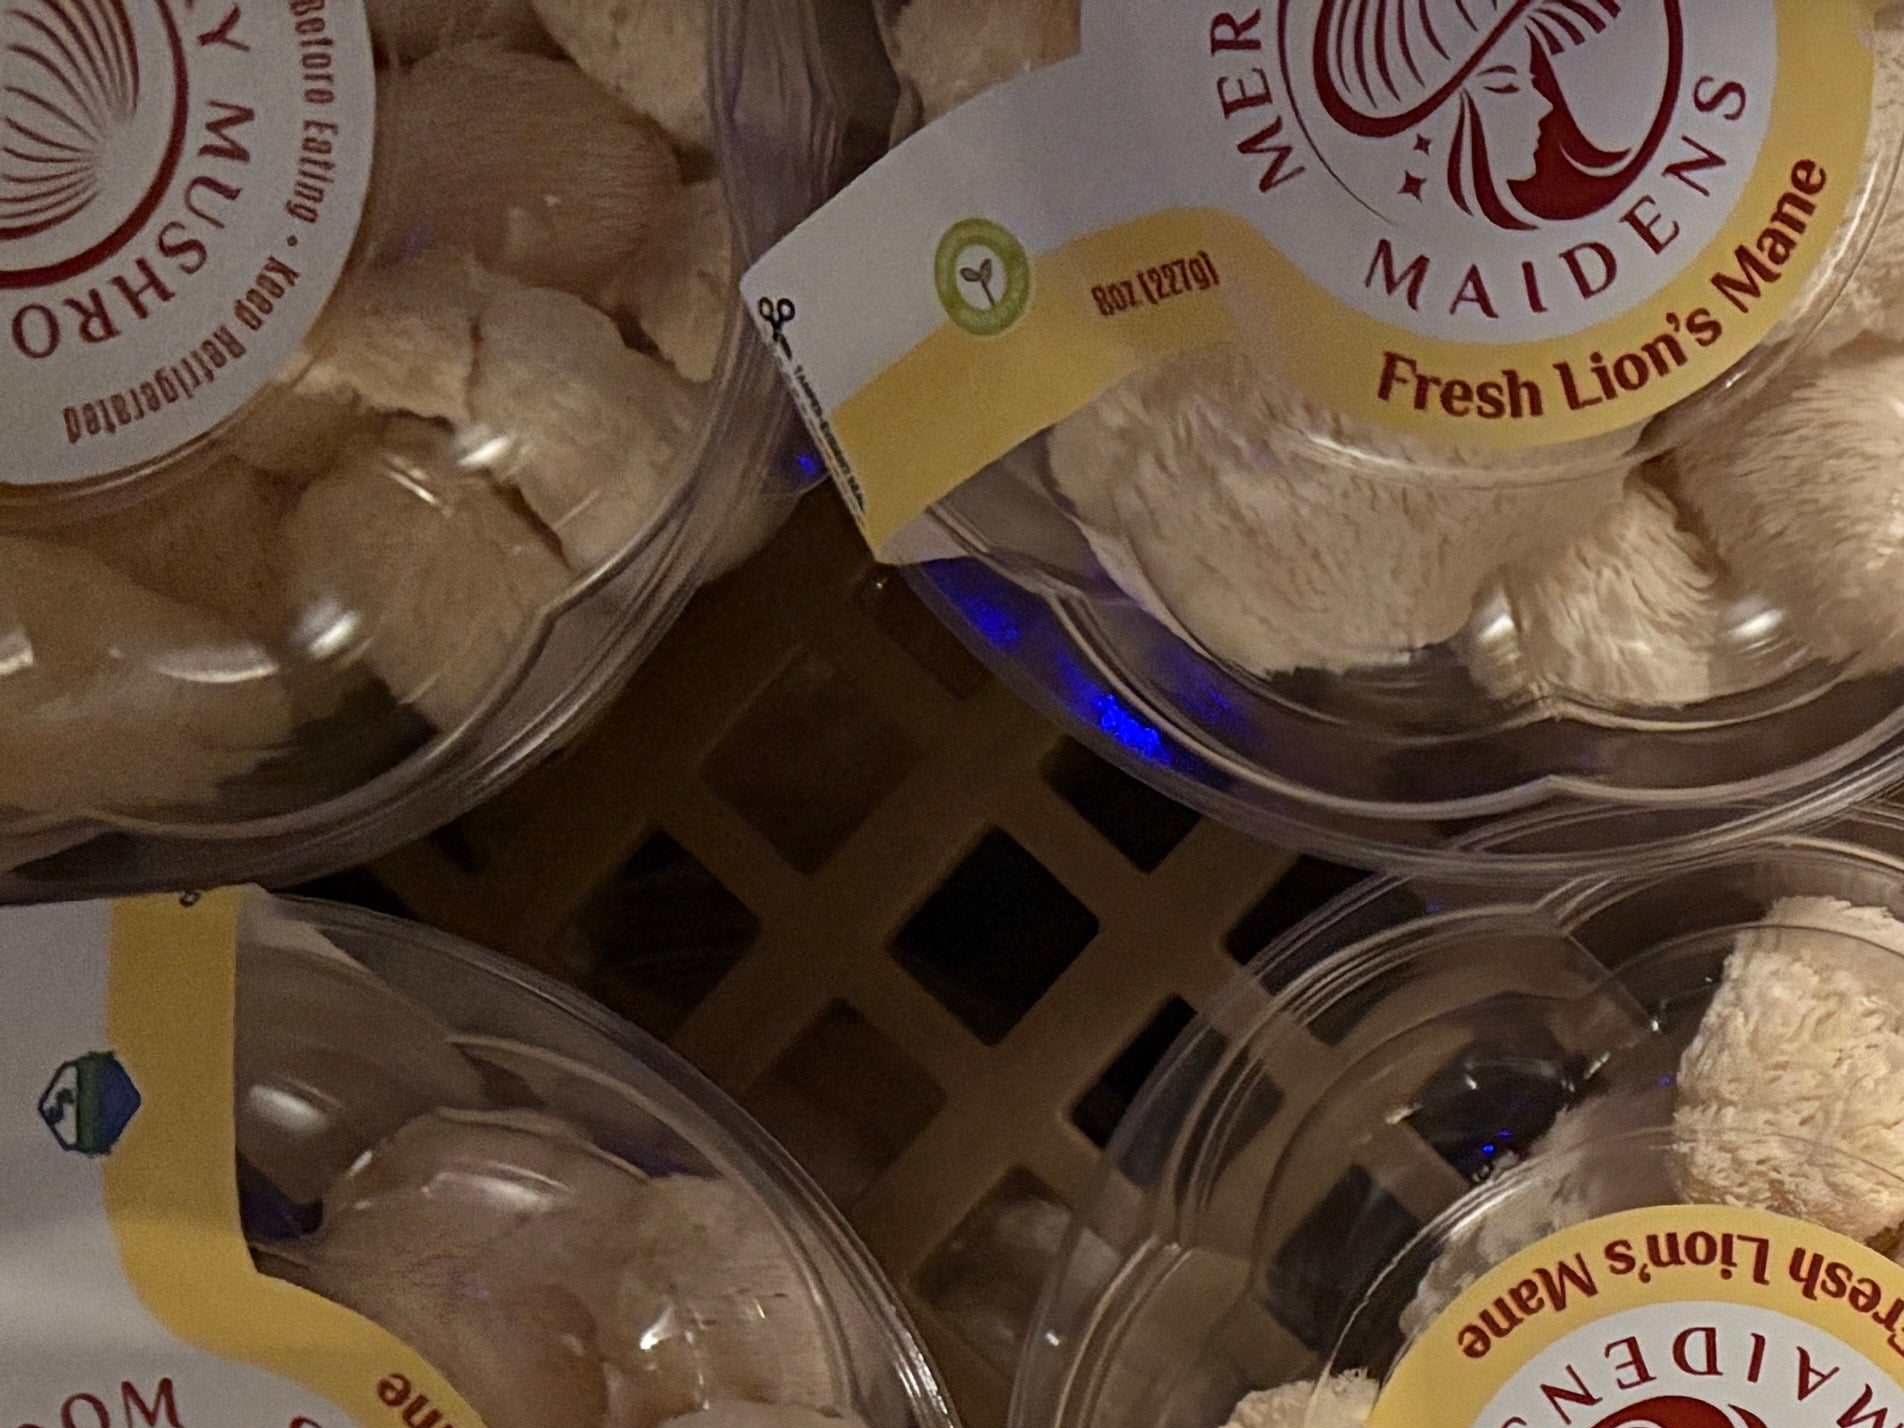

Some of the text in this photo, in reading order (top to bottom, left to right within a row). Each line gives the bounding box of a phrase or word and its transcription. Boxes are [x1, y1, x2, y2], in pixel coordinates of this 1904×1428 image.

[1209, 10, 1302, 191] MER
[1369, 76, 1746, 316] MAIDENS
[12, 100, 253, 357] MUSHRO
[1378, 157, 1827, 420] Fresh Lion's Mane
[1455, 1254, 1595, 1360] Mane
[1602, 1230, 1769, 1285] Lion's
